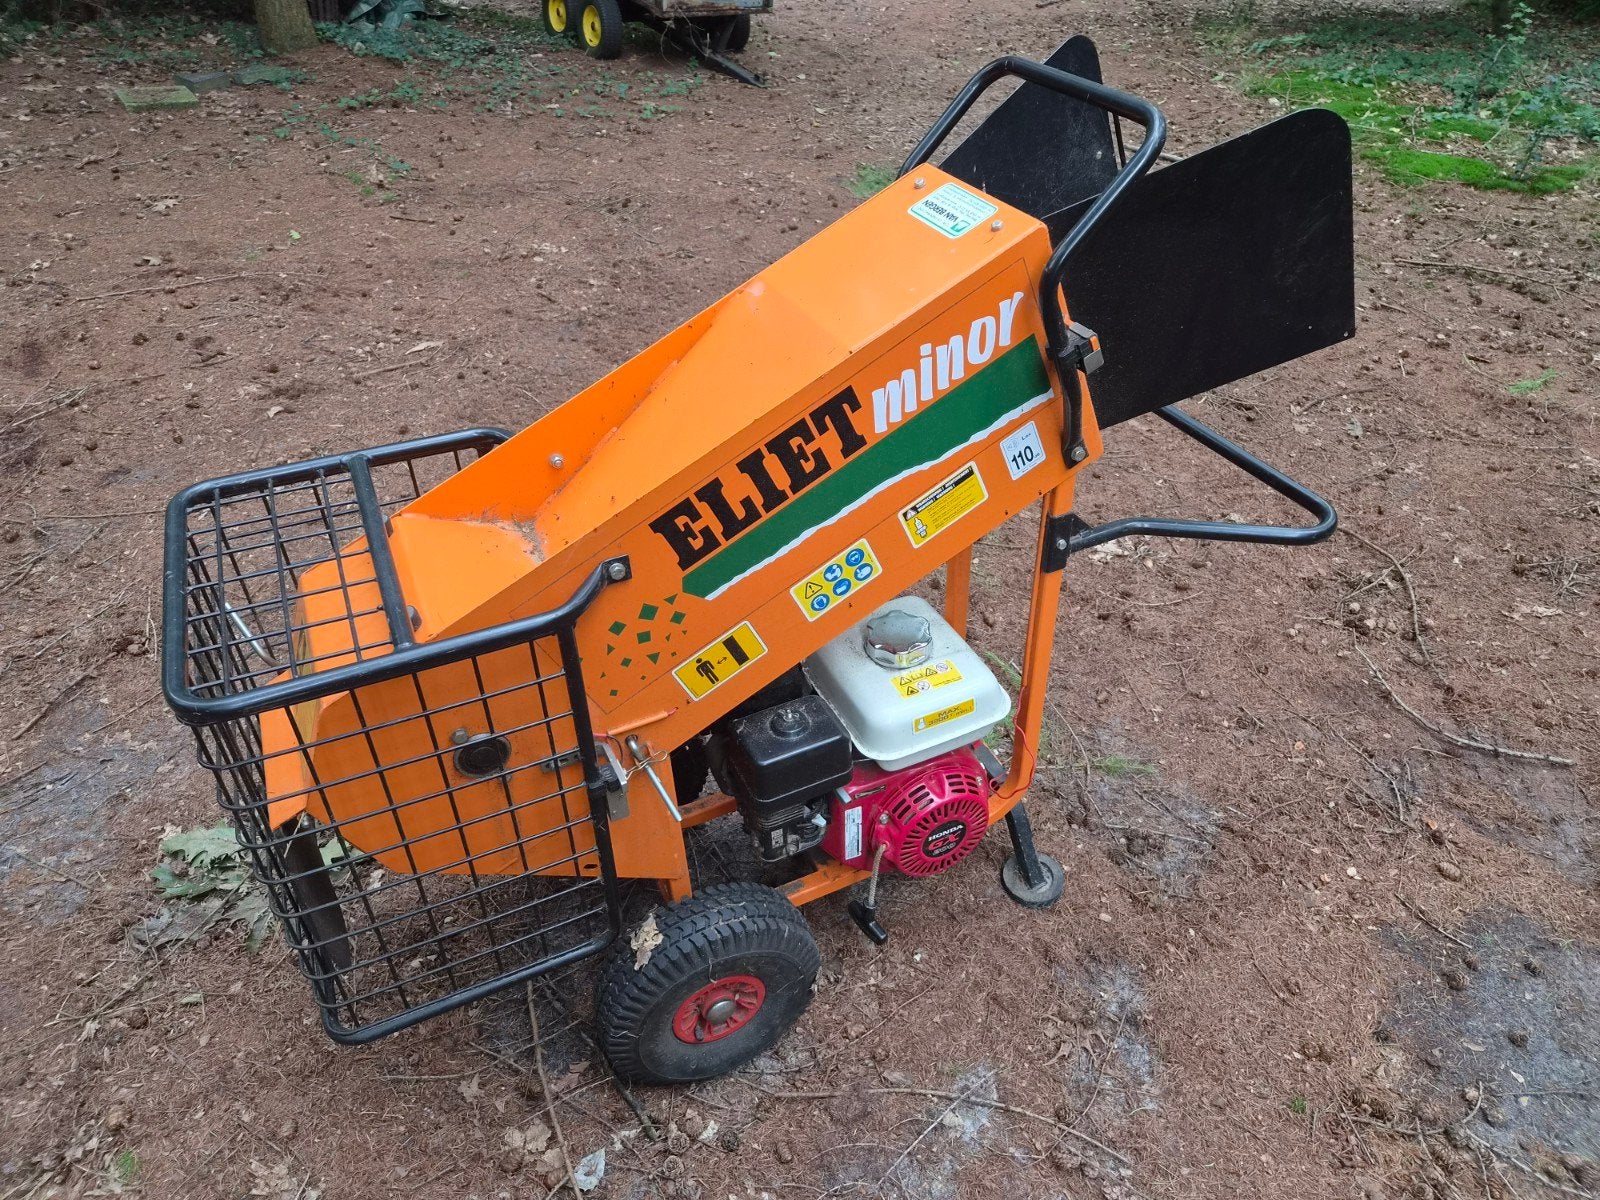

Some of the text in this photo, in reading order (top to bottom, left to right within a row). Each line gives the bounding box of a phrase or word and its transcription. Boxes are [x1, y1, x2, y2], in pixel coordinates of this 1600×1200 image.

[922, 199, 948, 216] BERGEN
[944, 210, 960, 223] VAN
[648, 291, 1024, 572] ELIET minor
[1011, 445, 1034, 470] 110
[928, 824, 964, 842] HONDA
[928, 830, 962, 851] GX
